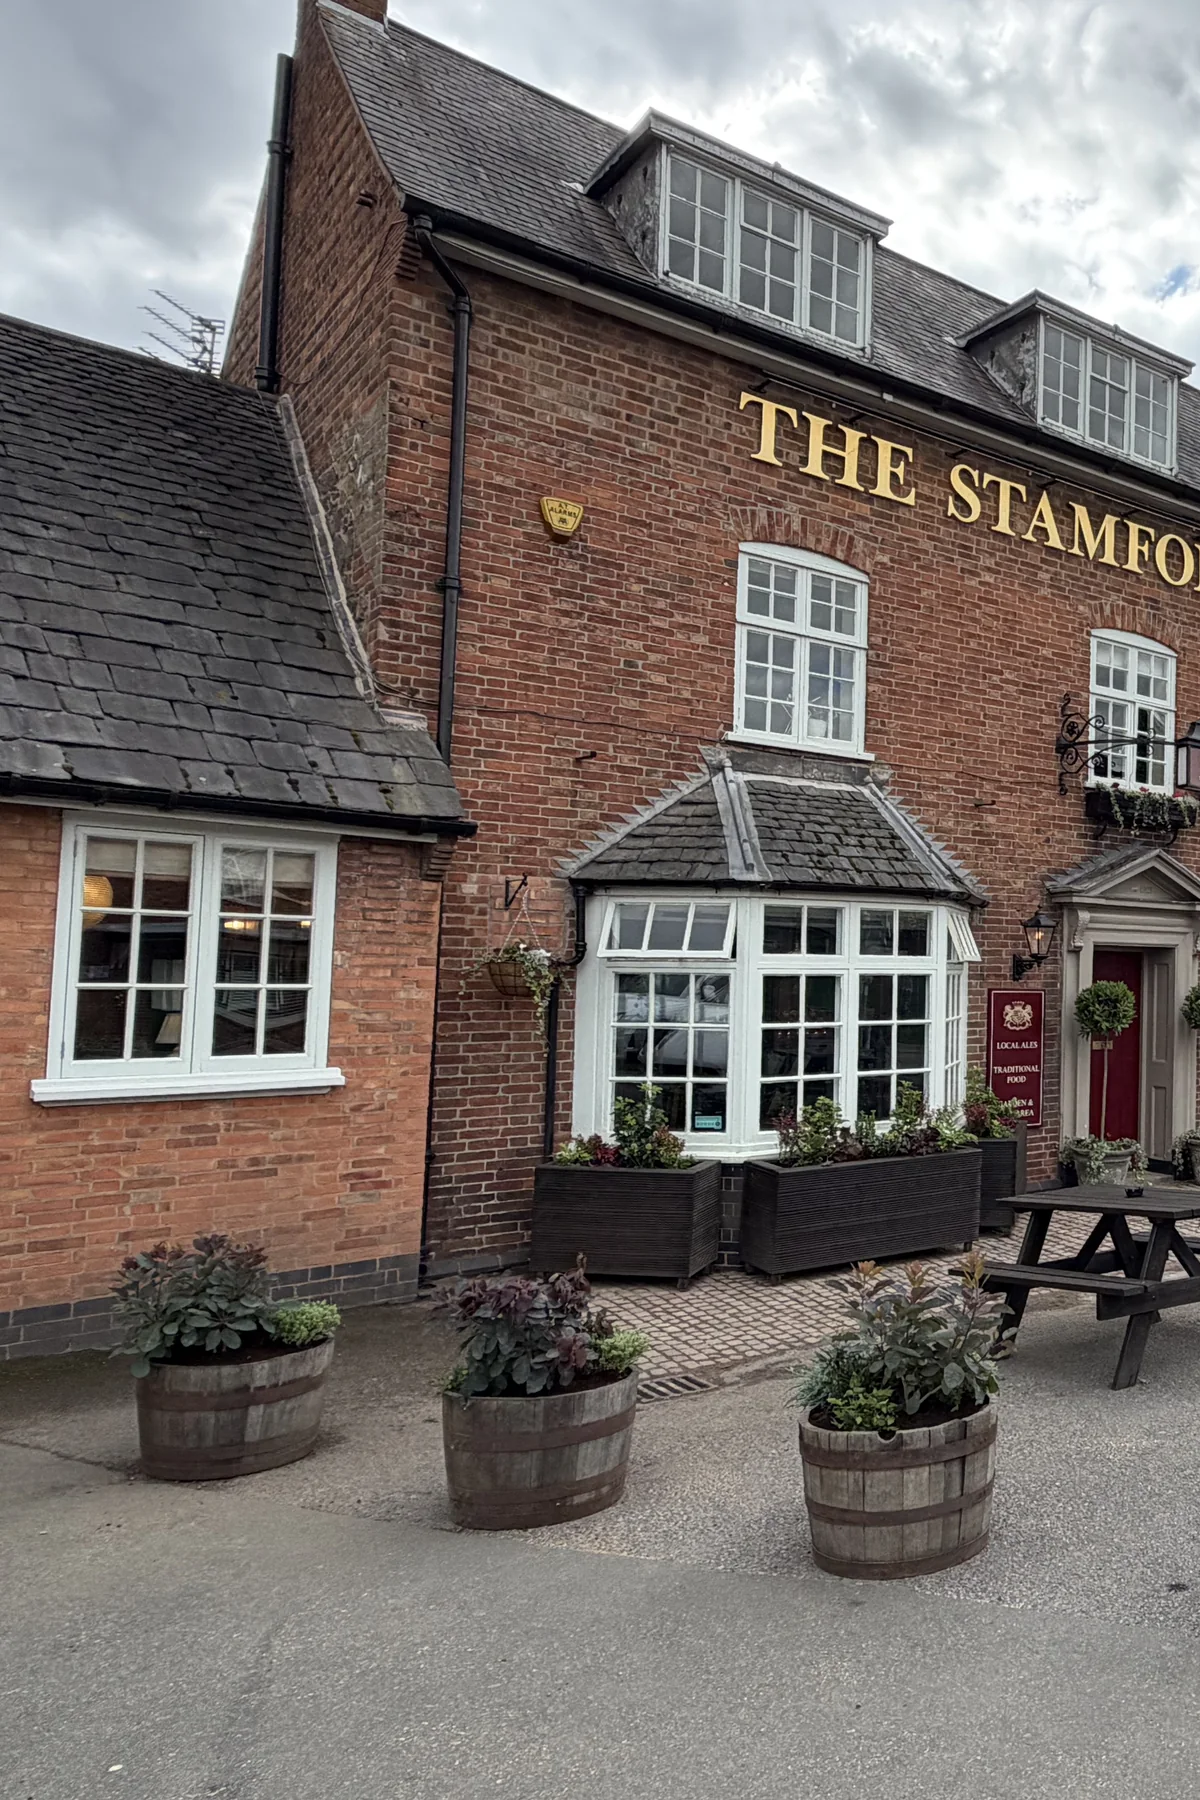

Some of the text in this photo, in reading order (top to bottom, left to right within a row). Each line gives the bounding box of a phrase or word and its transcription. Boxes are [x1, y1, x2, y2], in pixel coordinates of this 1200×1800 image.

[738, 390, 917, 508] THE
[549, 507, 577, 518] ALARMS
[1021, 1041, 1038, 1049] ALES
[993, 1065, 1040, 1073] TRADITIONAL
[1006, 1075, 1026, 1083] FOOD
[1027, 1098, 1034, 1107] &
